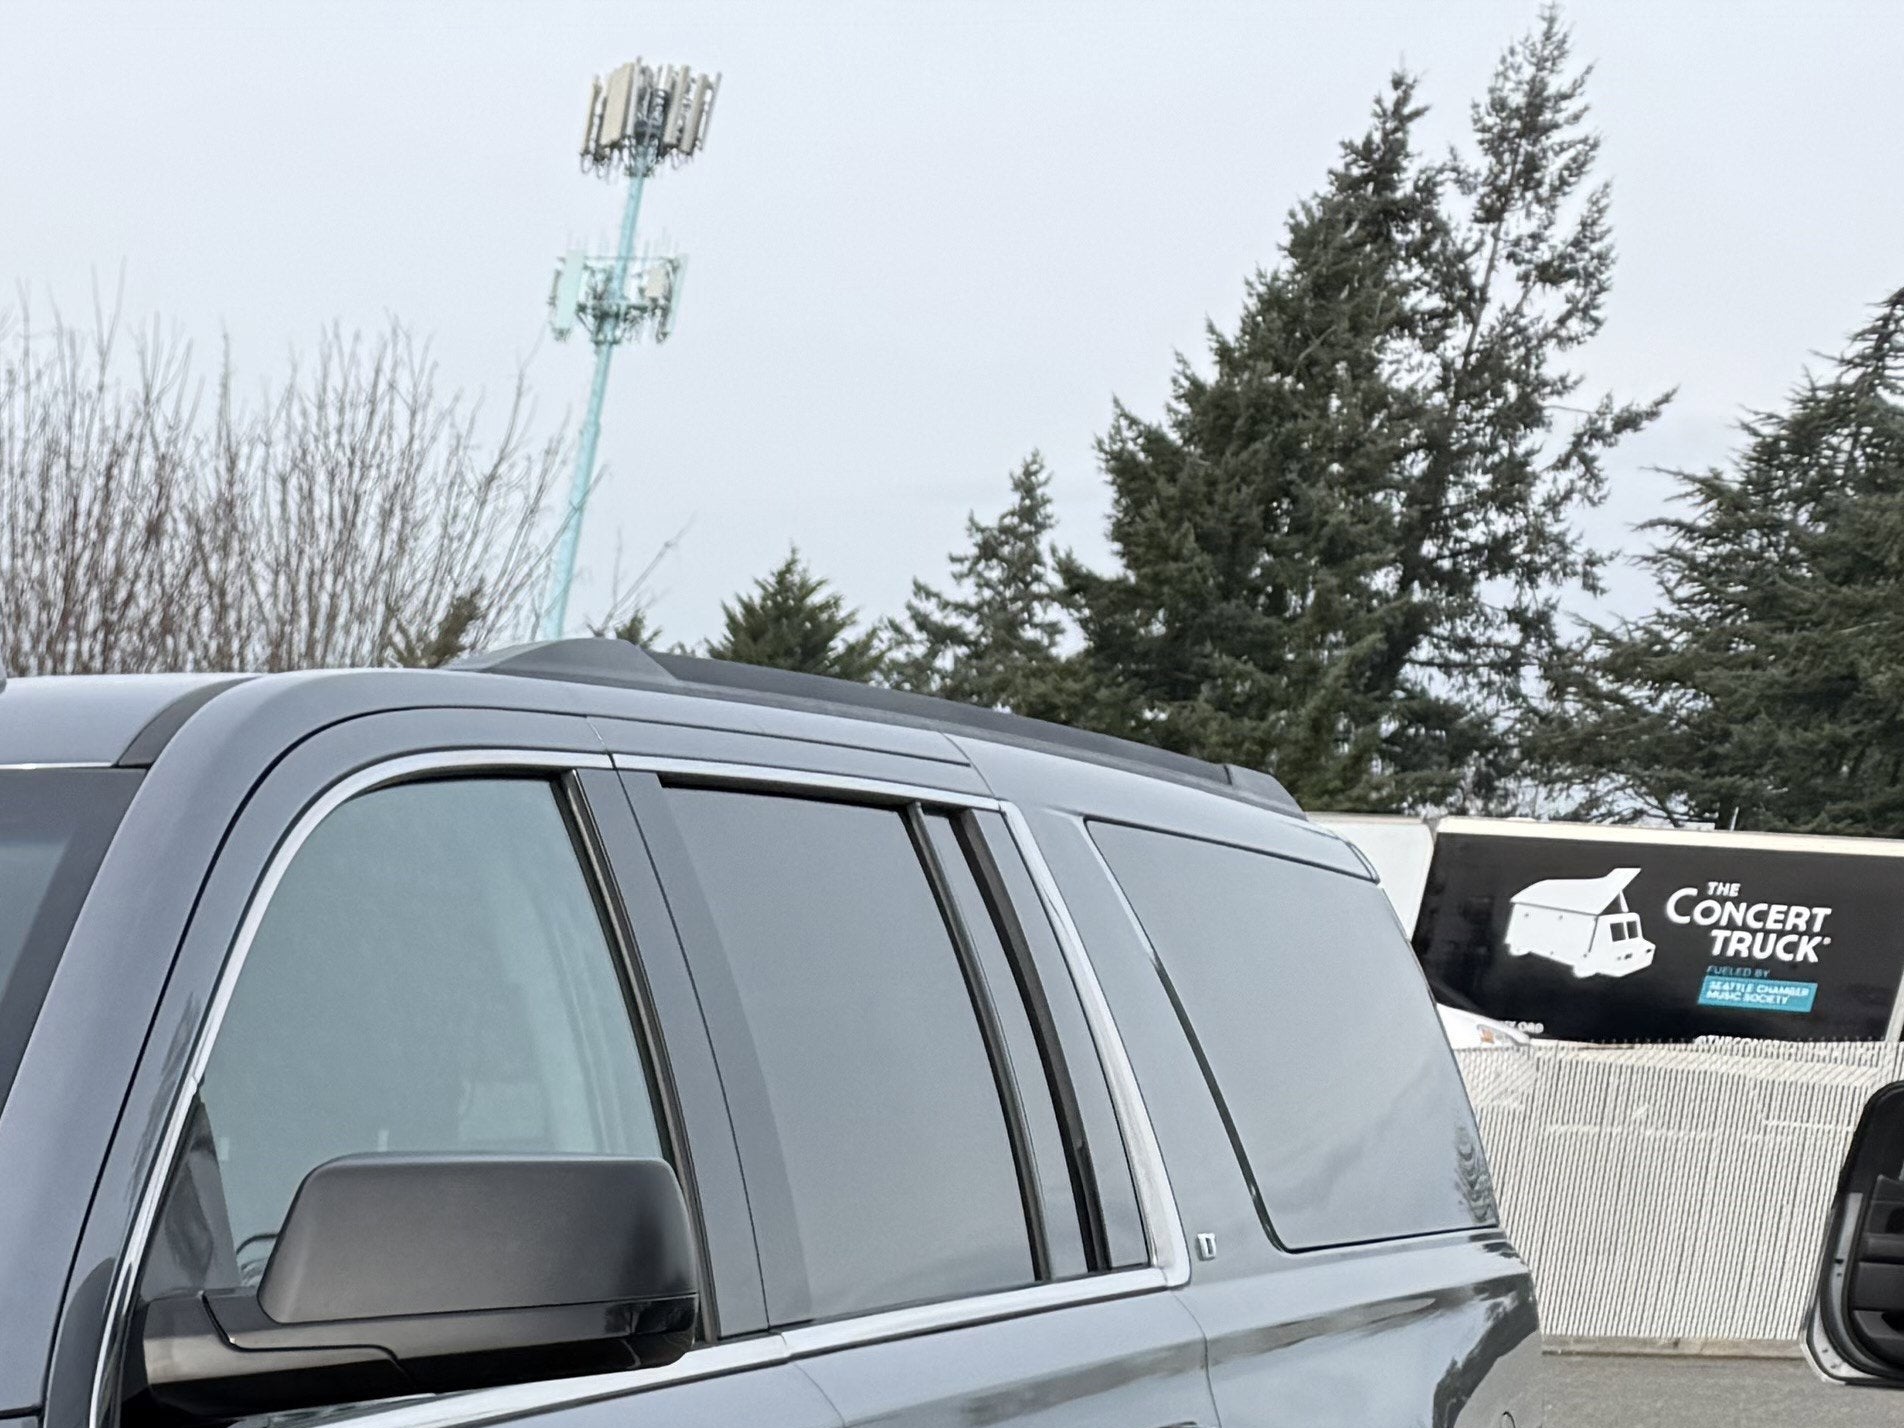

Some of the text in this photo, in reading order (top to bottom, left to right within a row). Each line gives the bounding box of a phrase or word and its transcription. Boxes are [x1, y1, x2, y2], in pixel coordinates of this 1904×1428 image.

[1707, 881, 1741, 897] THE
[1666, 887, 1832, 932] CONCERT
[1710, 929, 1819, 963] TRUCK
[1706, 965, 1770, 978] FUELED BY
[1709, 980, 1810, 997] SEATTLE CHAMBER
[1705, 990, 1790, 1005] MUSIC SOCIETY
